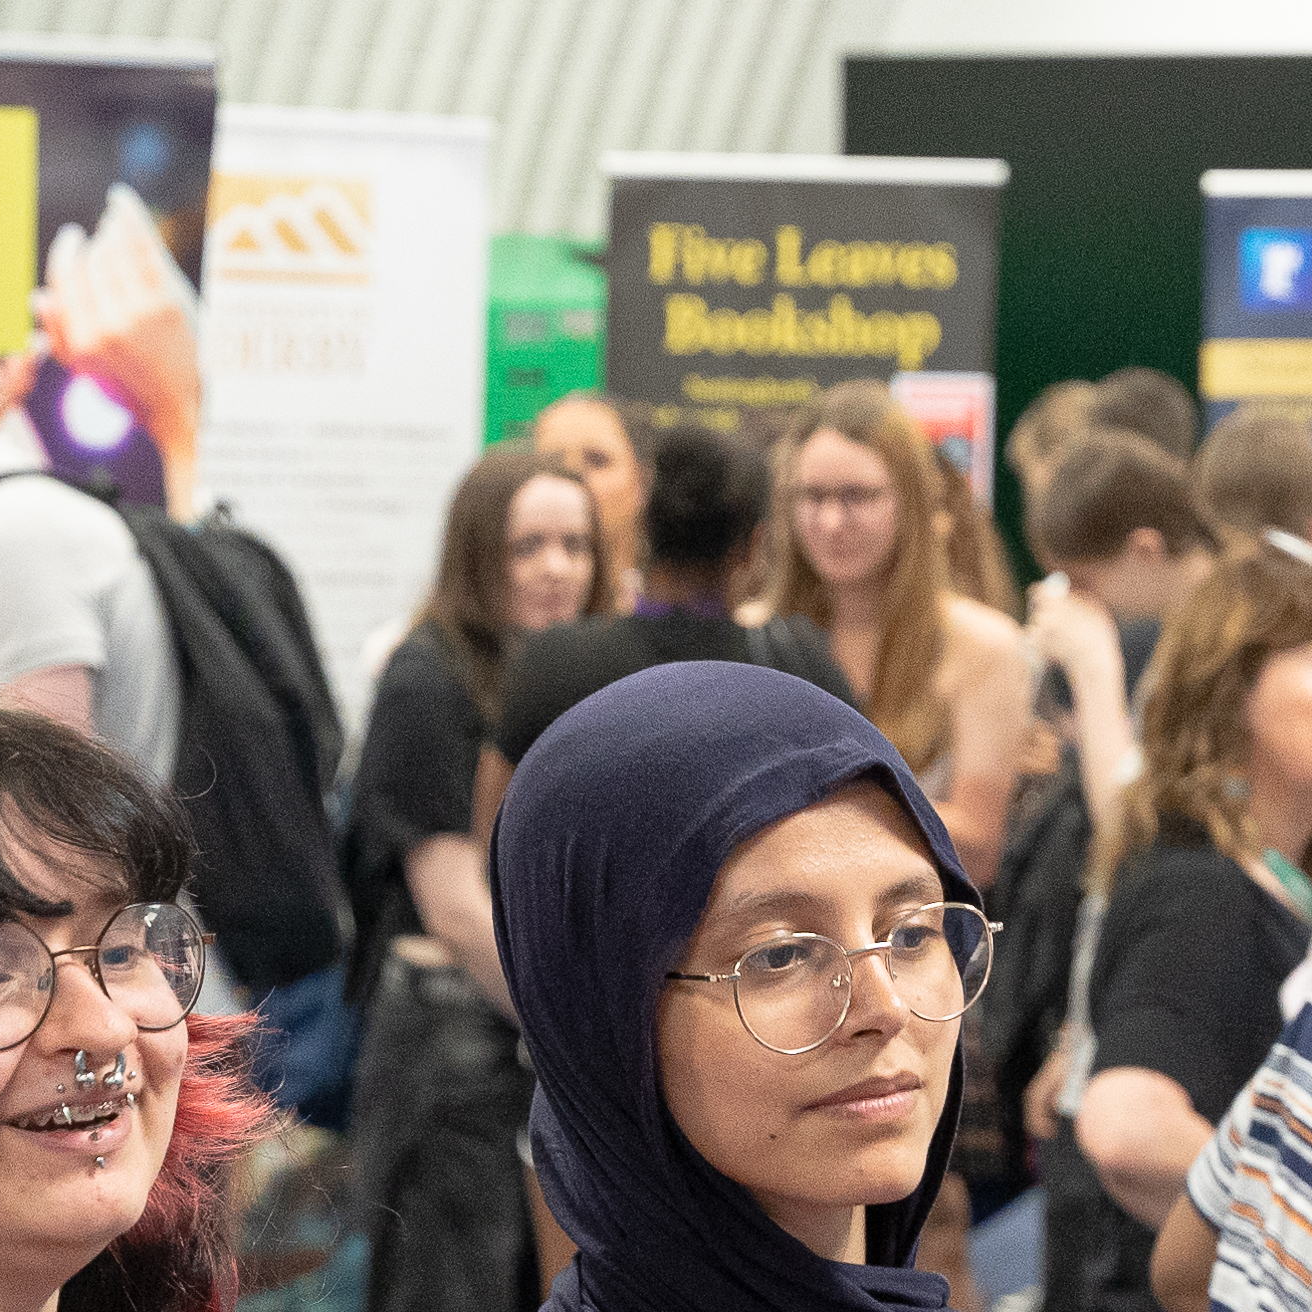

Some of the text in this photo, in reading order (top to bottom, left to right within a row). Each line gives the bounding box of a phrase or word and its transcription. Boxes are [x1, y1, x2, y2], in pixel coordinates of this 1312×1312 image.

[648, 221, 959, 291] Five Leaves
[664, 291, 943, 373] Bookshop
